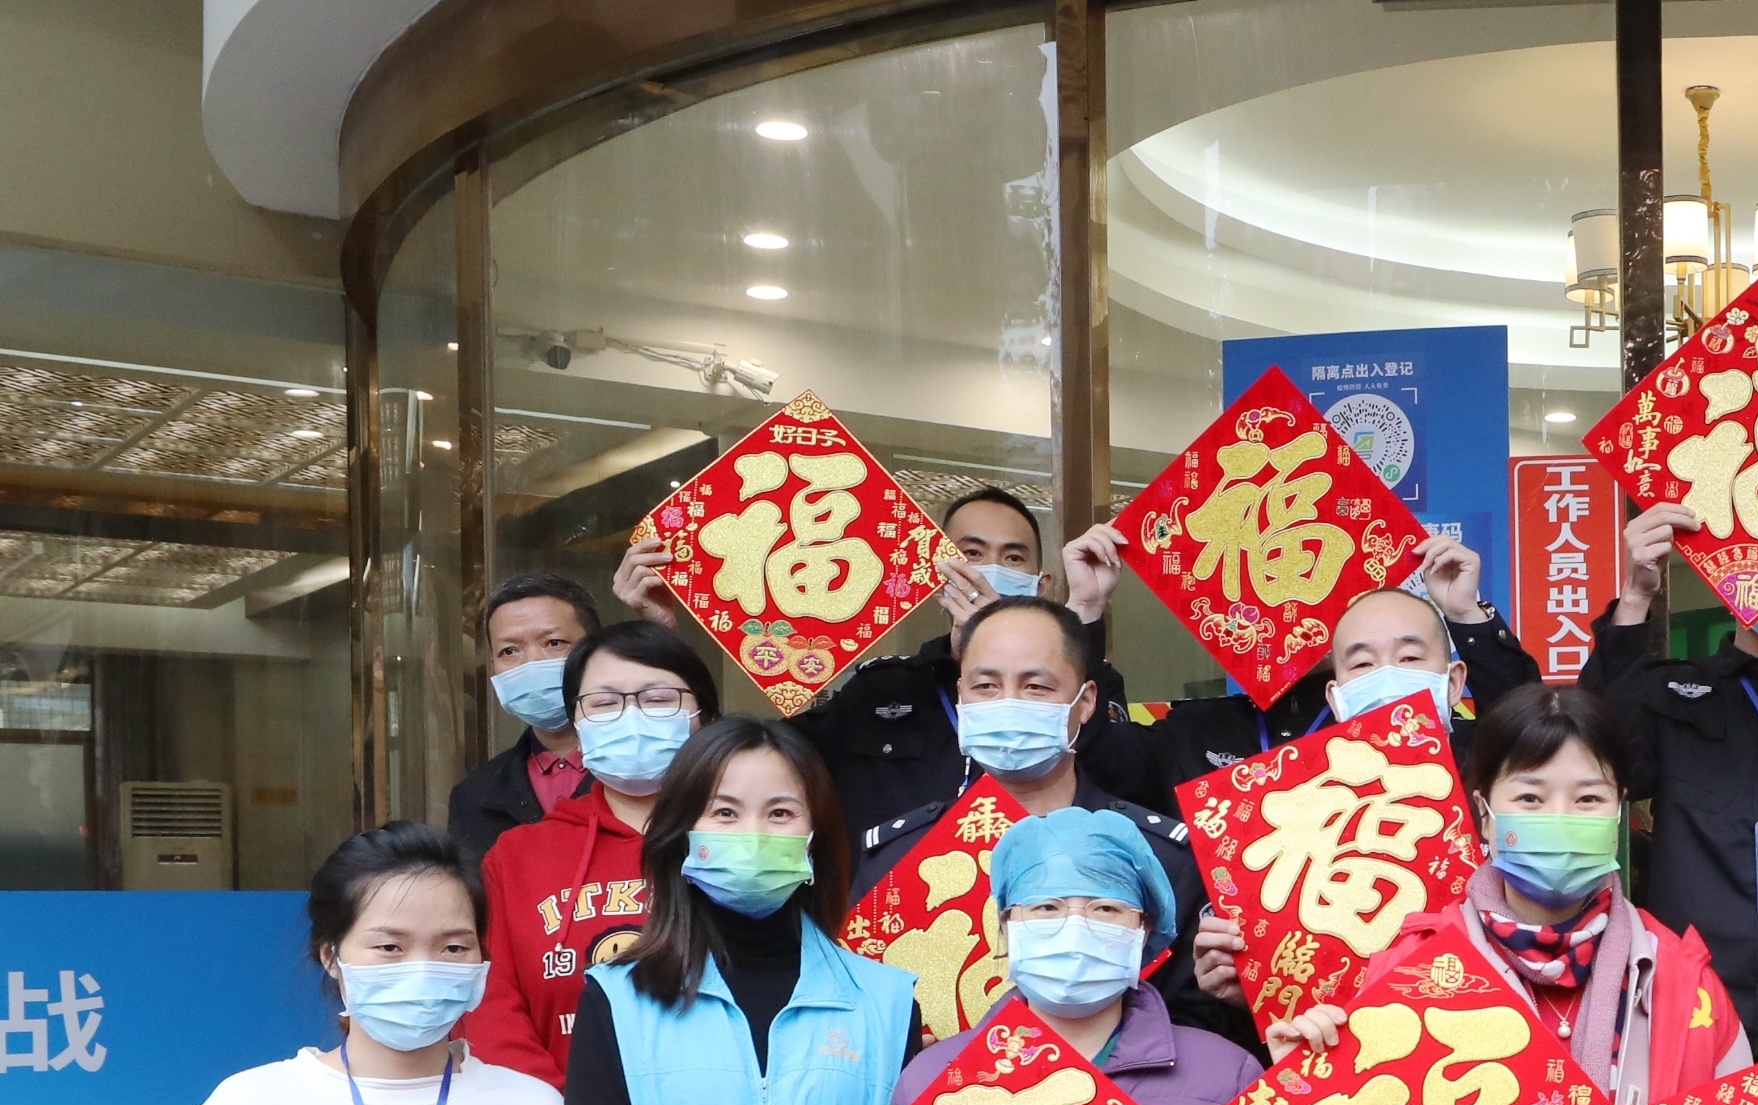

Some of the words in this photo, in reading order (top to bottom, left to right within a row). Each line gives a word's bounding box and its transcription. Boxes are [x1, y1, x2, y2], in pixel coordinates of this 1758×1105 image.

[769, 424, 846, 447] 好日子
[1312, 361, 1414, 381] 隔离点出入登记
[698, 451, 884, 623] 福
[1185, 432, 1355, 607] 福
[1543, 466, 1592, 674] 工作人员出入口
[1242, 736, 1454, 958] 福
[0, 970, 107, 1074] 战
